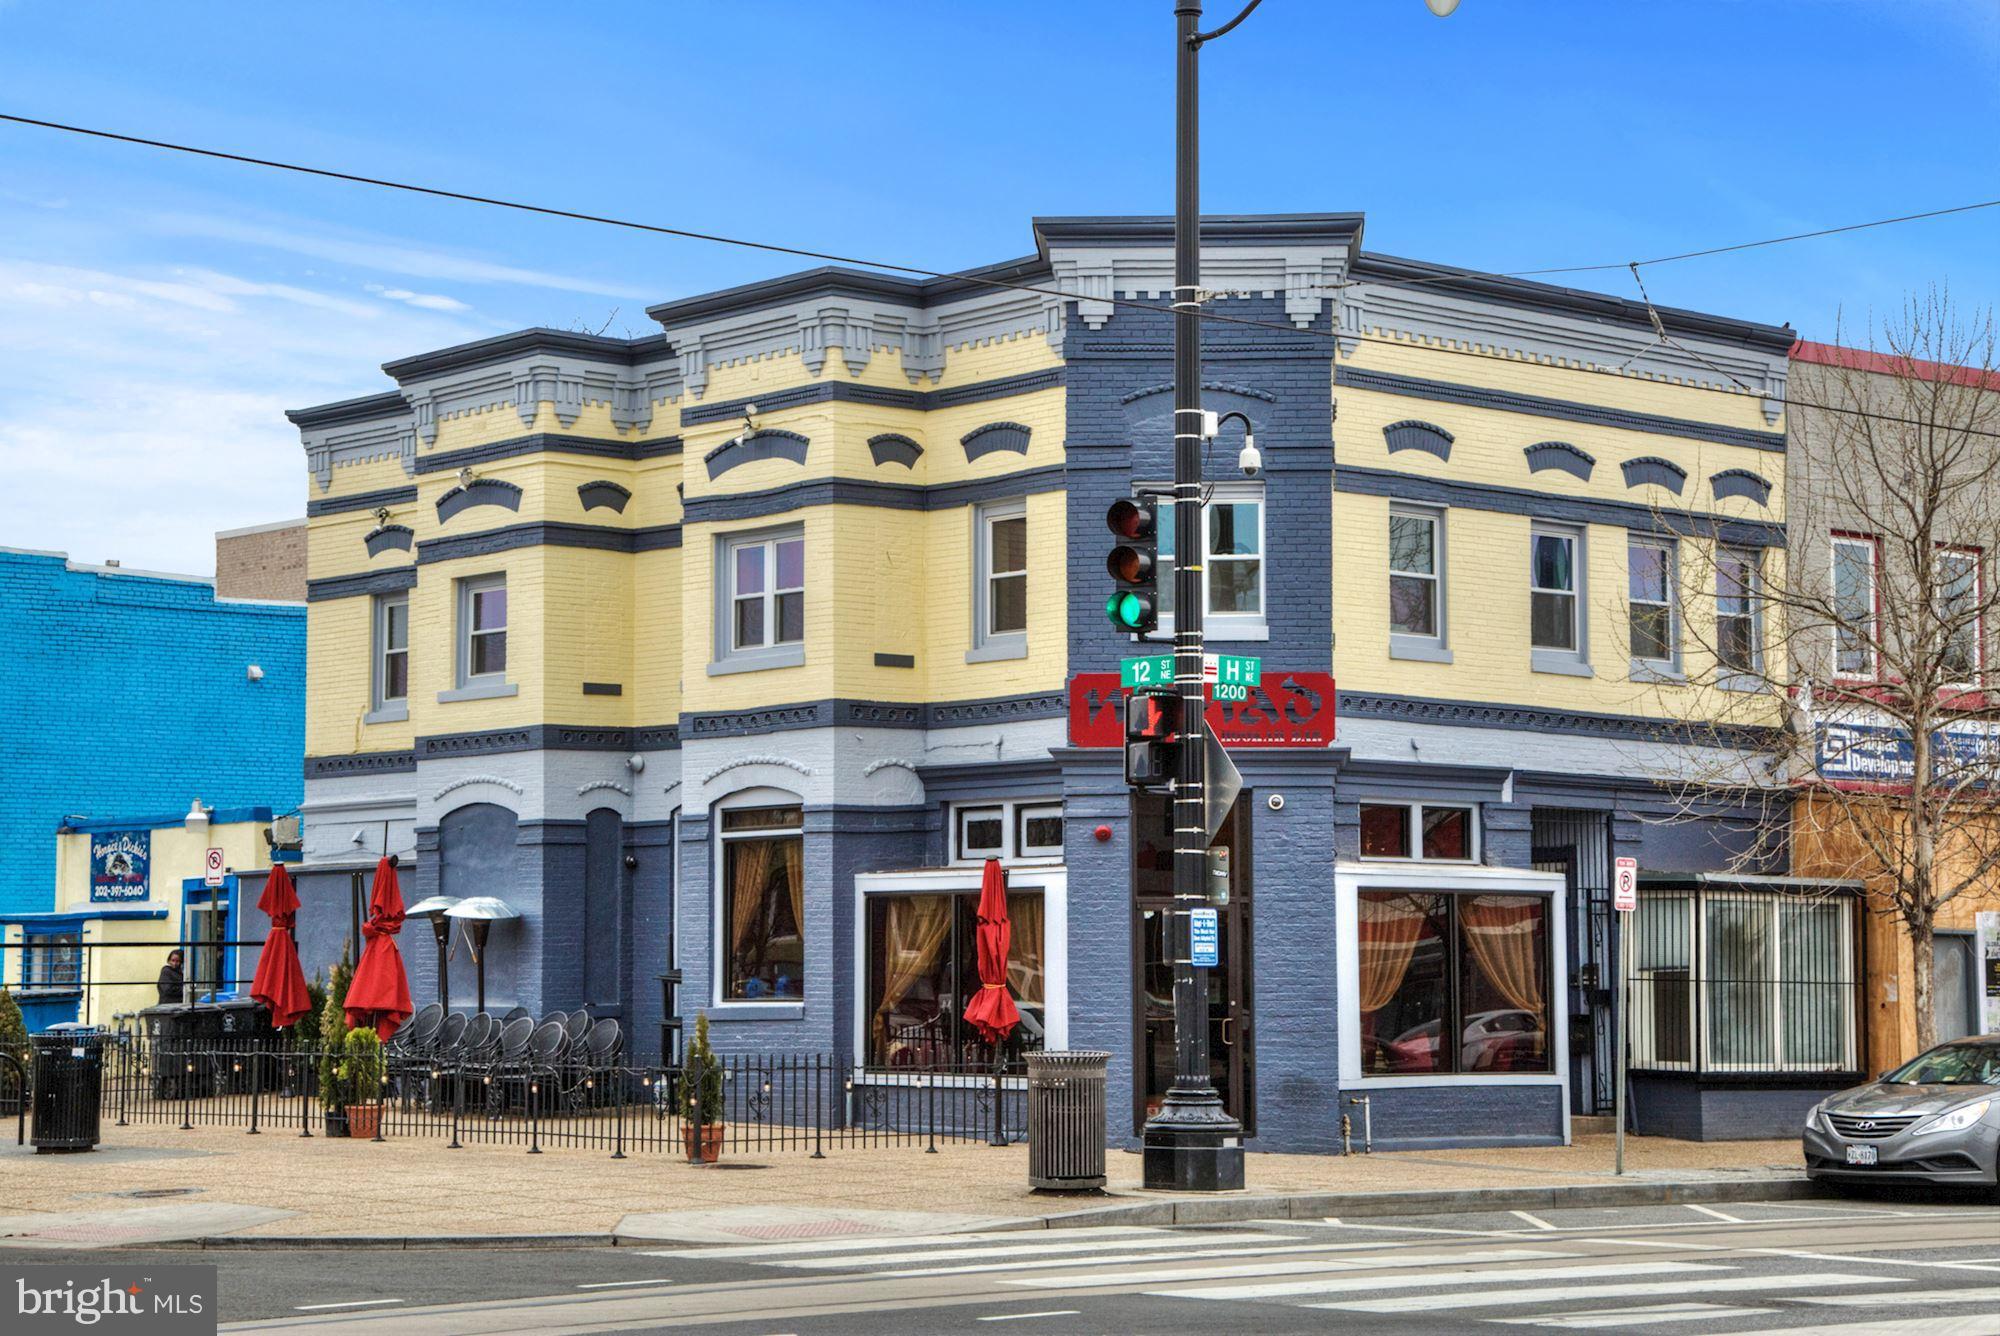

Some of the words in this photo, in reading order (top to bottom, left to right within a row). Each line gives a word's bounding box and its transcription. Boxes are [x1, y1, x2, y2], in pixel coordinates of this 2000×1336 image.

[1132, 661, 1151, 683] 12
[1161, 660, 1171, 669] ST
[1160, 670, 1171, 679] NE
[1226, 660, 1239, 681] H
[1245, 661, 1255, 671] ST
[1245, 672, 1254, 682] NE
[1214, 684, 1247, 700] 1200
[1852, 754, 1915, 778] Developme
[95, 885, 144, 897] 202-397-6040
